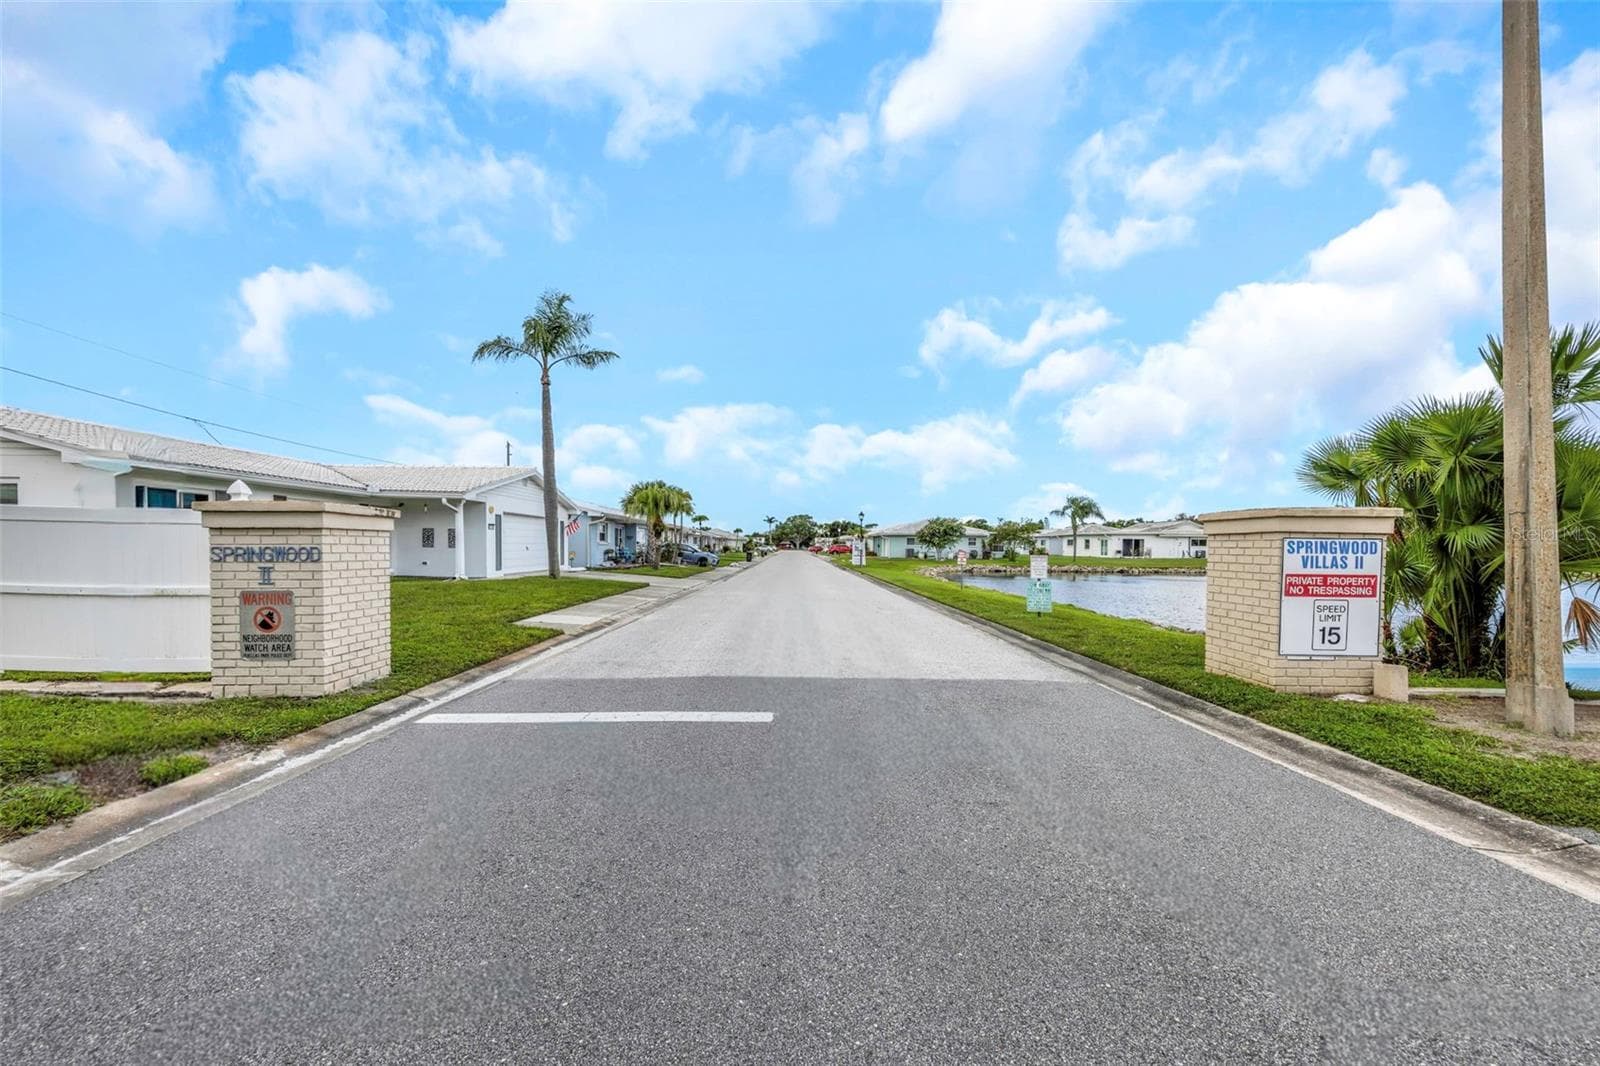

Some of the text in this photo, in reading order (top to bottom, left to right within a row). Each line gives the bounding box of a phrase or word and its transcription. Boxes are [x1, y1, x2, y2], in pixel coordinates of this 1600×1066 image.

[1286, 541, 1377, 555] SPRINGWOOD
[210, 546, 321, 563] SPRINGWOOD
[1301, 555, 1364, 569] VILLAS II
[257, 566, 274, 585] II
[1286, 576, 1376, 586] PRIVATE PROPERTY
[1289, 586, 1372, 595] NO TRESPASSING
[242, 592, 293, 605] WARNING
[1316, 605, 1346, 613] SPEED
[1319, 614, 1342, 622] LIMIT
[243, 634, 292, 643] NEIGHBORHOOD
[1319, 626, 1341, 645] 15
[244, 644, 292, 652] WATCH AREA
